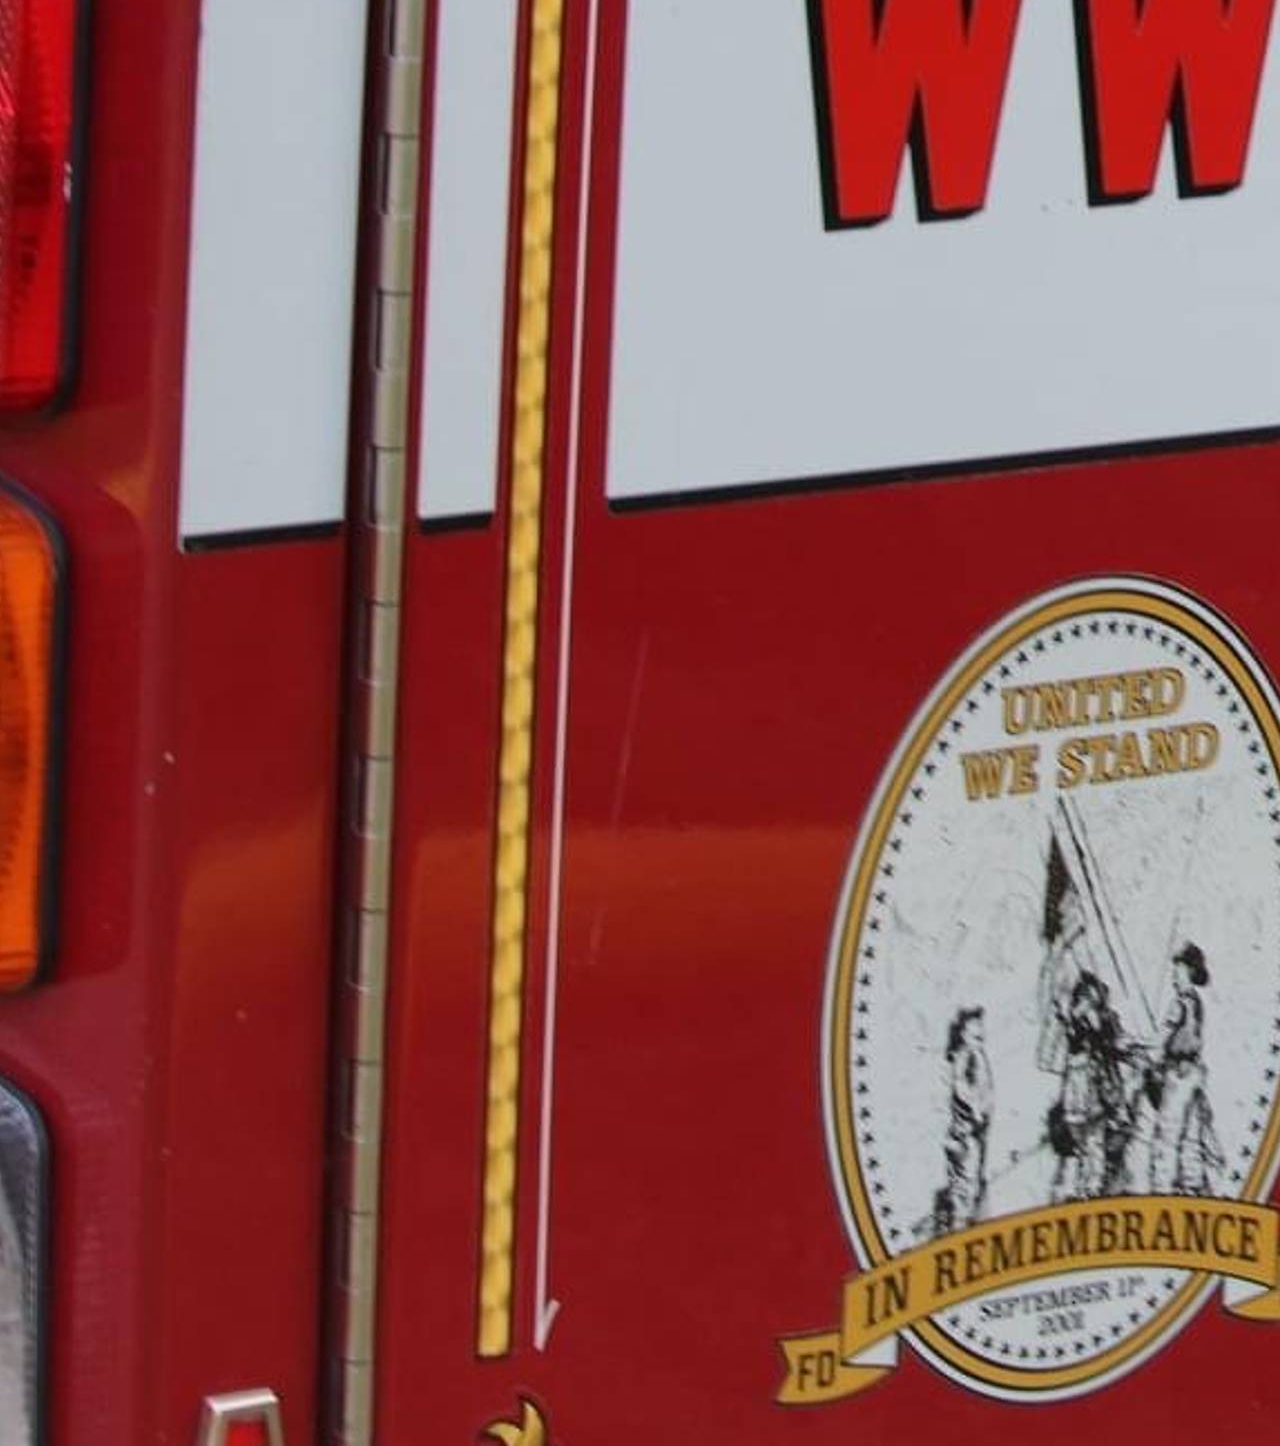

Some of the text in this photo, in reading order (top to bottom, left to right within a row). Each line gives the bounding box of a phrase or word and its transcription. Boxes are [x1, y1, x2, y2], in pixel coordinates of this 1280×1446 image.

[1001, 667, 1186, 735] UNITED
[961, 721, 1220, 801] WE STAND
[866, 1209, 1261, 1328] IN REMEMBRANCE
[979, 1280, 1112, 1323] SEPTEMBER
[795, 1349, 837, 1392] FD
